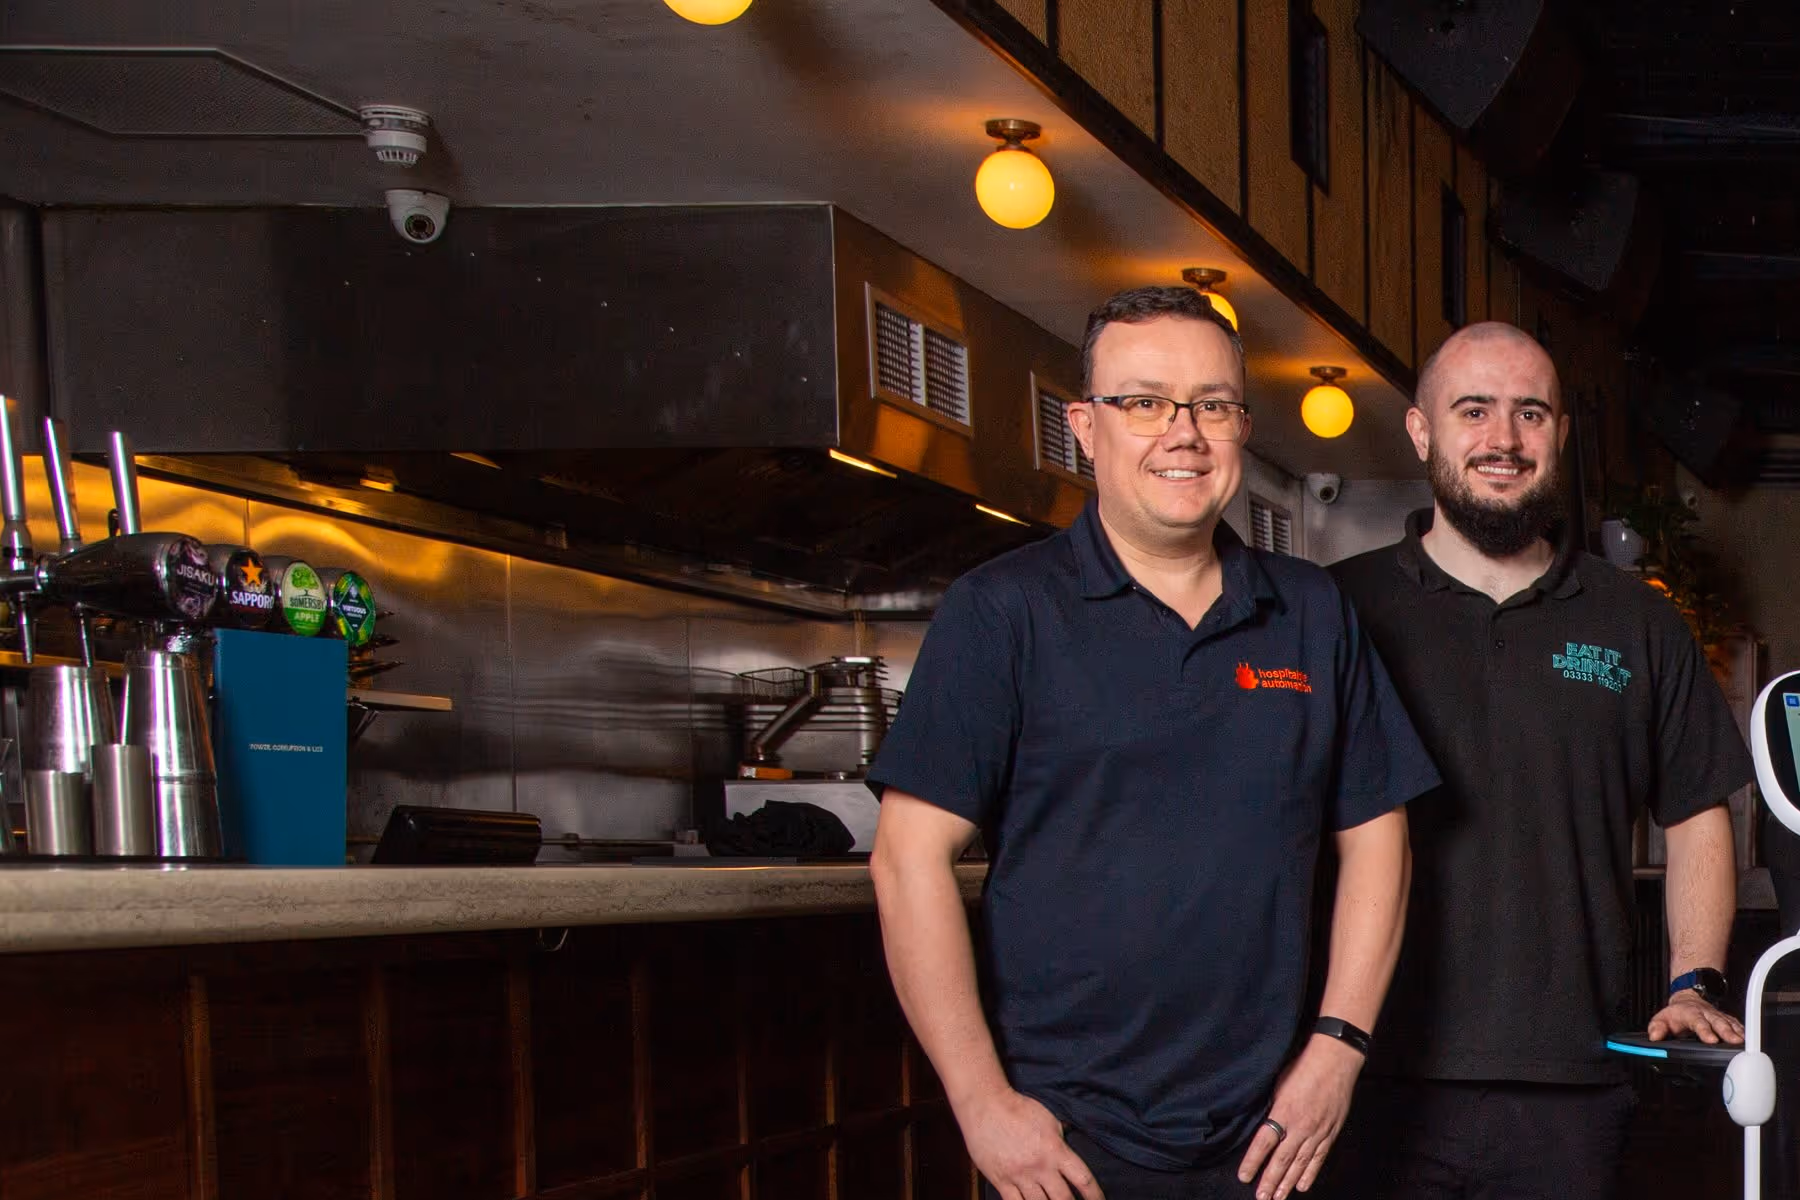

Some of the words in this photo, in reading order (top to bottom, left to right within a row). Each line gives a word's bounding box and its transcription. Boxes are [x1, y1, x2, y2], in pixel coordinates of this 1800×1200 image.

[176, 564, 215, 586] JISAKU
[232, 590, 274, 609] SAPPORO
[294, 611, 321, 623] APPLE
[1566, 642, 1602, 659] EAT
[1604, 648, 1622, 666] IT
[1552, 654, 1614, 680] DRINK
[1563, 669, 1593, 682] 03333
